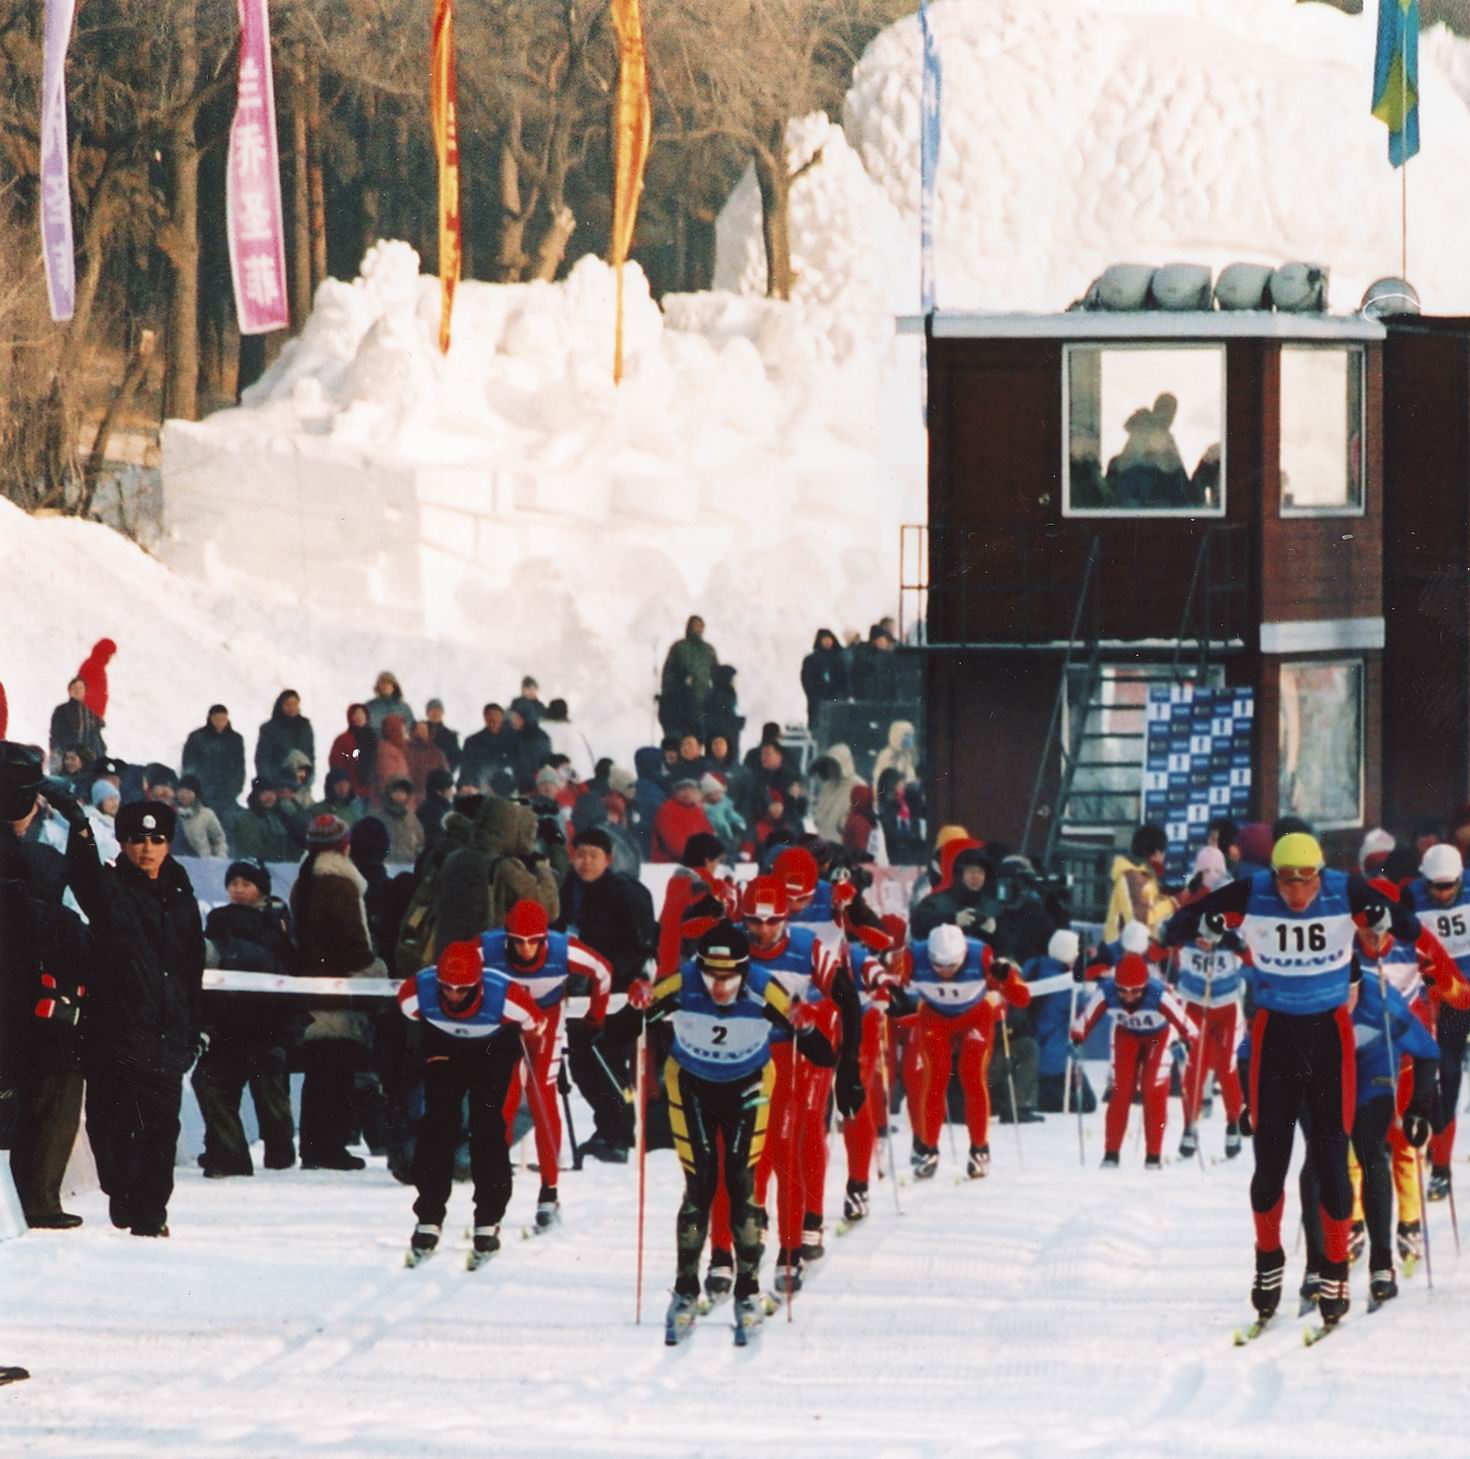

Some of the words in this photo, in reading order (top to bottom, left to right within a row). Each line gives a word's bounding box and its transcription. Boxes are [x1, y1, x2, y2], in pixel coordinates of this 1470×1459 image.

[236, 56, 280, 305] 兰乔圣菲
[1275, 923, 1327, 953] 116
[1437, 914, 1467, 938] 95
[711, 1025, 728, 1046] 2
